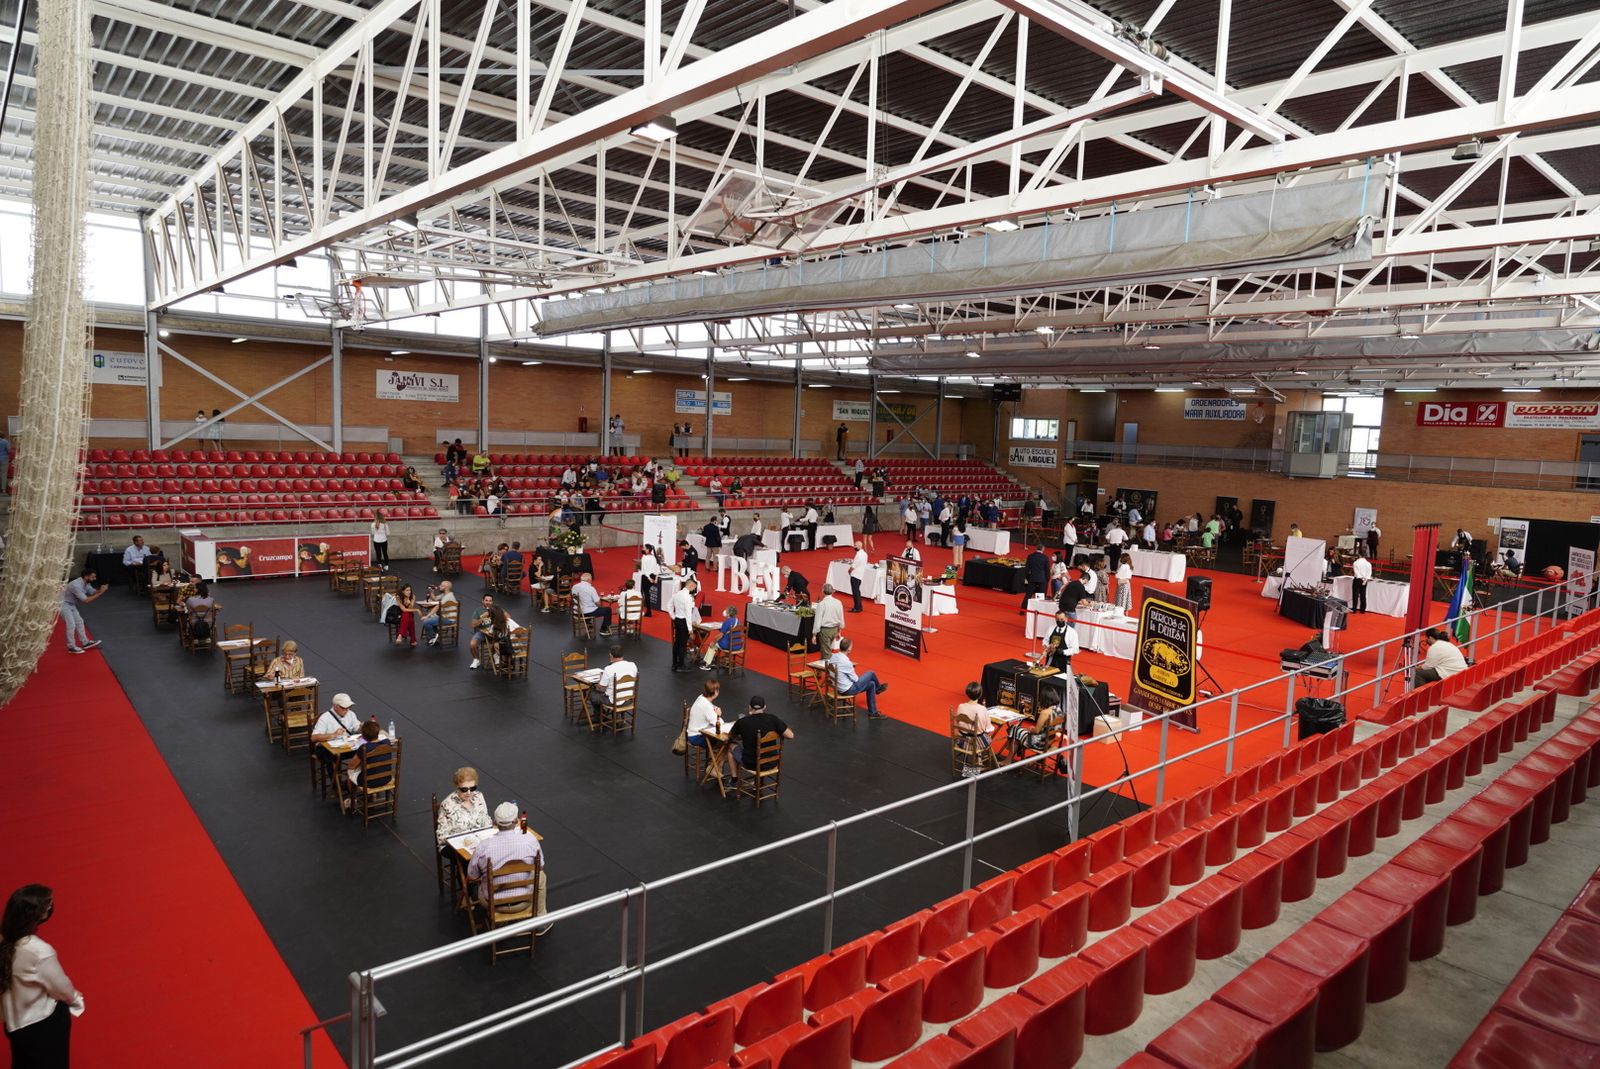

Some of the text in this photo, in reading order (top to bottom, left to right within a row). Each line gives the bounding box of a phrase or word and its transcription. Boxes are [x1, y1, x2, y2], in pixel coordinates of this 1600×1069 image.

[1423, 403, 1468, 422] Dia
[1028, 455, 1056, 464] MIGUEL
[258, 554, 293, 563] Cruzcampo
[890, 612, 916, 625] JAMONEROS
[1177, 620, 1187, 632] de
[1157, 624, 1186, 643] DEHESA
